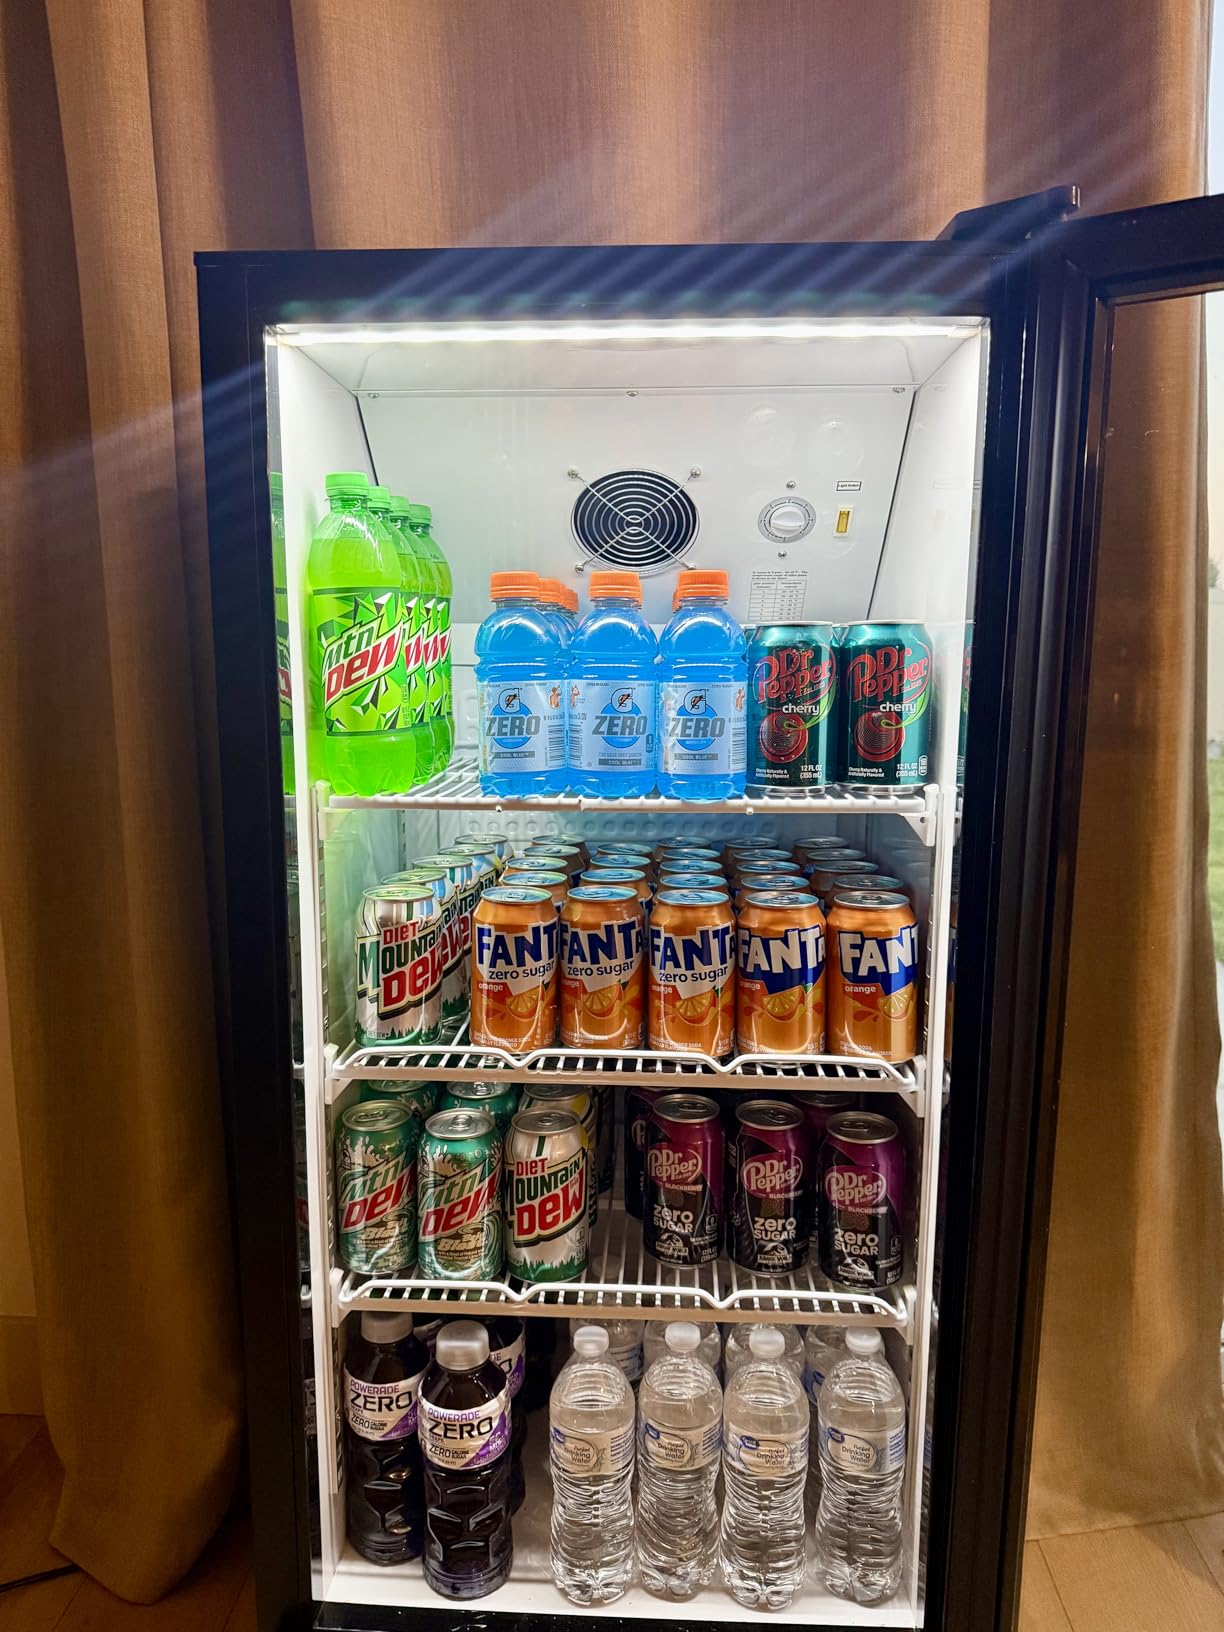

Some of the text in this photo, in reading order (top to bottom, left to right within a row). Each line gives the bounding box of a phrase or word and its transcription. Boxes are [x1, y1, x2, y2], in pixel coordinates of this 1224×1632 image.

[323, 626, 374, 676] Mtn
[779, 648, 814, 677] Dr
[876, 647, 912, 677] Dr
[754, 656, 831, 704] Pepper
[849, 654, 928, 702] Pepper
[782, 703, 820, 715] cherry
[880, 701, 917, 713] cherry
[486, 716, 541, 737] ZERO
[592, 715, 648, 736] ZERO
[669, 717, 726, 738] ZERO
[489, 960, 555, 980] zero sugar
[567, 960, 634, 976] zero sugar
[659, 966, 728, 983] zero sugar
[478, 983, 503, 991] orange
[739, 981, 761, 991] orange
[845, 985, 876, 995] orange
[648, 1149, 697, 1181] Pepper
[662, 1149, 683, 1165] Dr
[745, 1161, 799, 1192] Pepper
[765, 1159, 787, 1177] Dr
[347, 1163, 399, 1202] Mtn
[826, 1172, 882, 1205] Pepper
[843, 1172, 866, 1189] Dr
[421, 1174, 478, 1211] Mtn
[653, 1204, 694, 1223] zero
[653, 1216, 693, 1232] SUGAR
[754, 1217, 796, 1230] zero
[753, 1229, 796, 1240] SUGAR
[834, 1228, 879, 1246] zero
[834, 1240, 879, 1255] SUGAR
[350, 1379, 400, 1396] POWERADE
[350, 1388, 412, 1412] ZERO
[351, 1413, 370, 1429] ZERO
[428, 1407, 481, 1423] POWERADE
[428, 1416, 493, 1440] ZERO
[429, 1443, 451, 1458] ZERO
[657, 1443, 685, 1455] Drinking
[756, 1452, 785, 1460] Drinking
[842, 1446, 871, 1459] Drinking
[850, 1455, 870, 1464] Water
